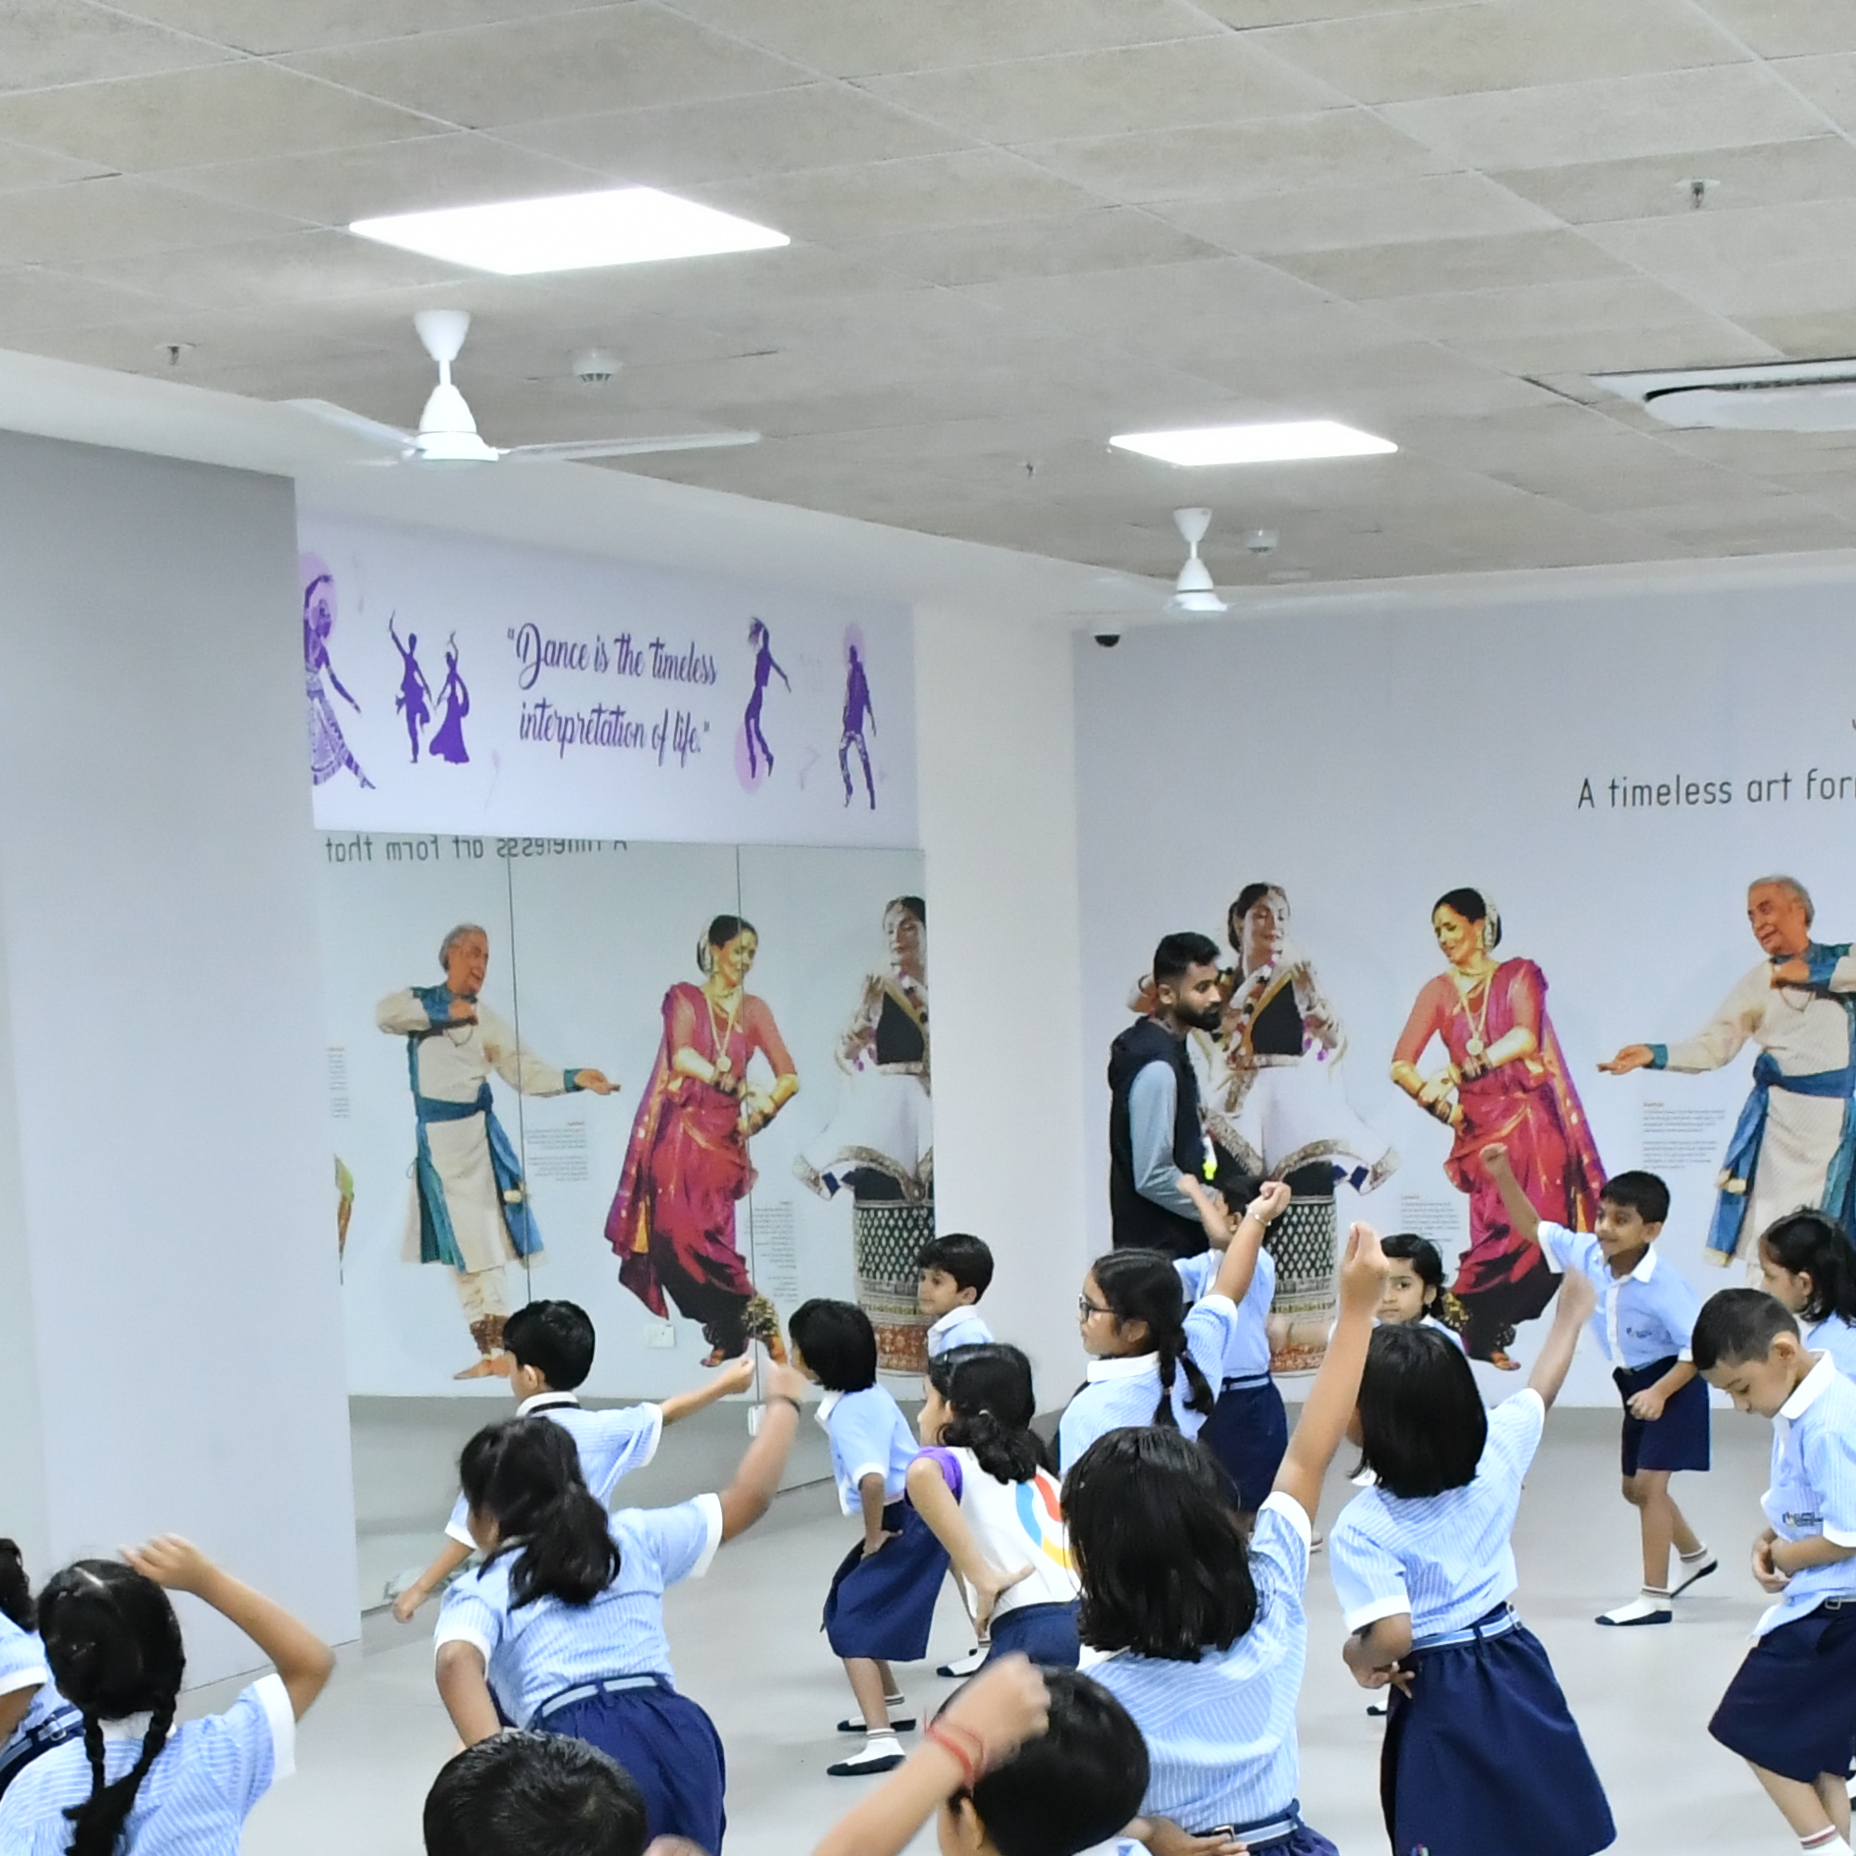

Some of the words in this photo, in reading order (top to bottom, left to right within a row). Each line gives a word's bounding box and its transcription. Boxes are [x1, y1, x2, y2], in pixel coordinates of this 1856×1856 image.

[594, 635, 609, 672] is
[614, 633, 643, 677] the
[649, 637, 717, 685] timeless
[519, 697, 645, 758] interpretation
[652, 709, 669, 765] of
[1578, 778, 1594, 808] A
[1609, 775, 1732, 807] timeless
[1747, 772, 1792, 803] art
